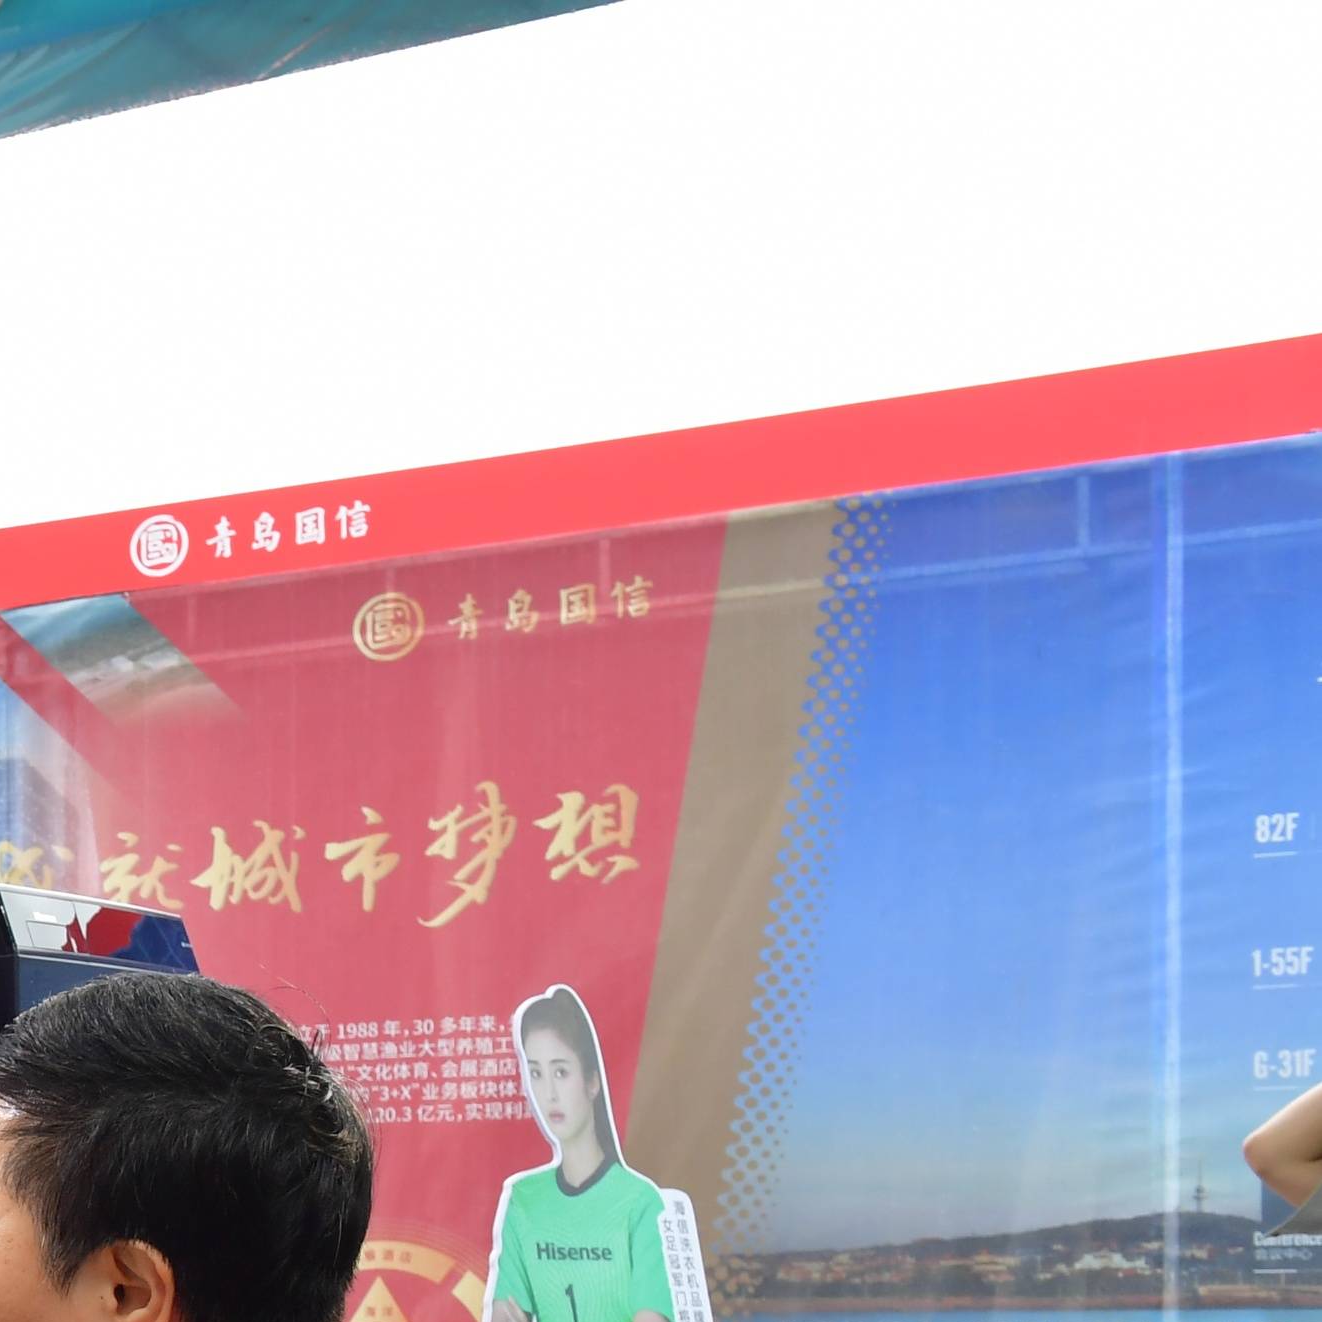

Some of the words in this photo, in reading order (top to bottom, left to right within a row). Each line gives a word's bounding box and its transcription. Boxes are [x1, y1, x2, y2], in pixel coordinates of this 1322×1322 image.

[205, 500, 371, 558] 青岛国信
[447, 576, 654, 639] 青岛国信
[1255, 812, 1300, 843] 82F
[1252, 946, 1315, 977] 1-55F
[337, 1022, 378, 1040] 1988
[1253, 1049, 1316, 1080] G-31F
[536, 1241, 613, 1262] Hisense
